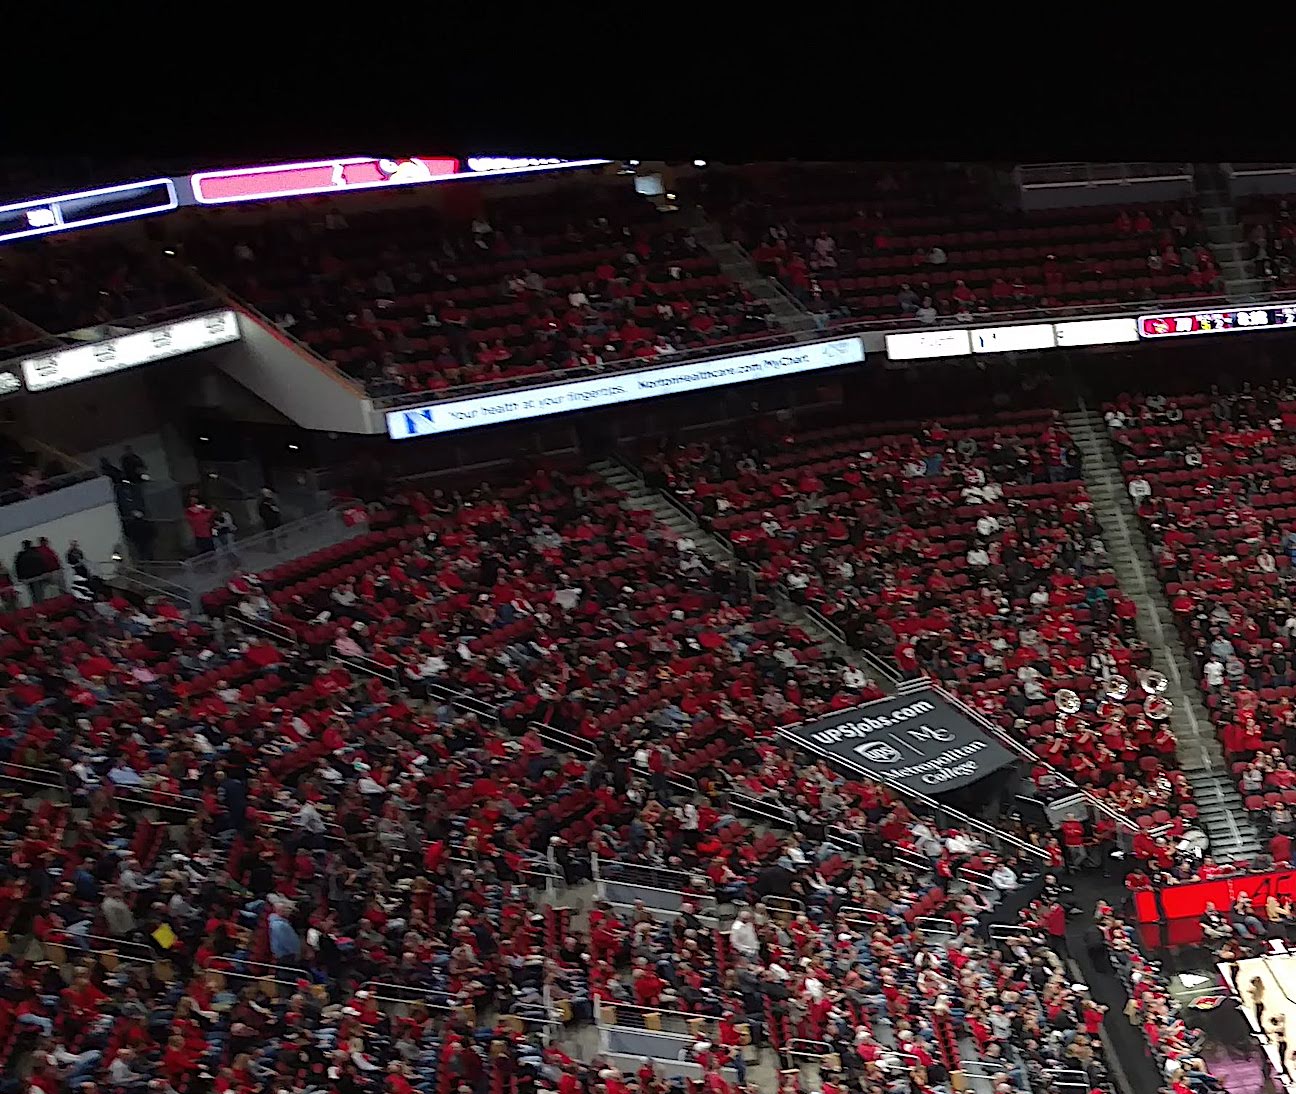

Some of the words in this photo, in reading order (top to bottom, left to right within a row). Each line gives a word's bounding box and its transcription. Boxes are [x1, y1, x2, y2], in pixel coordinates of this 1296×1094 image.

[811, 701, 936, 744] UPSjobs.com
[880, 739, 988, 782] Metropolitan
[921, 759, 979, 785] College
